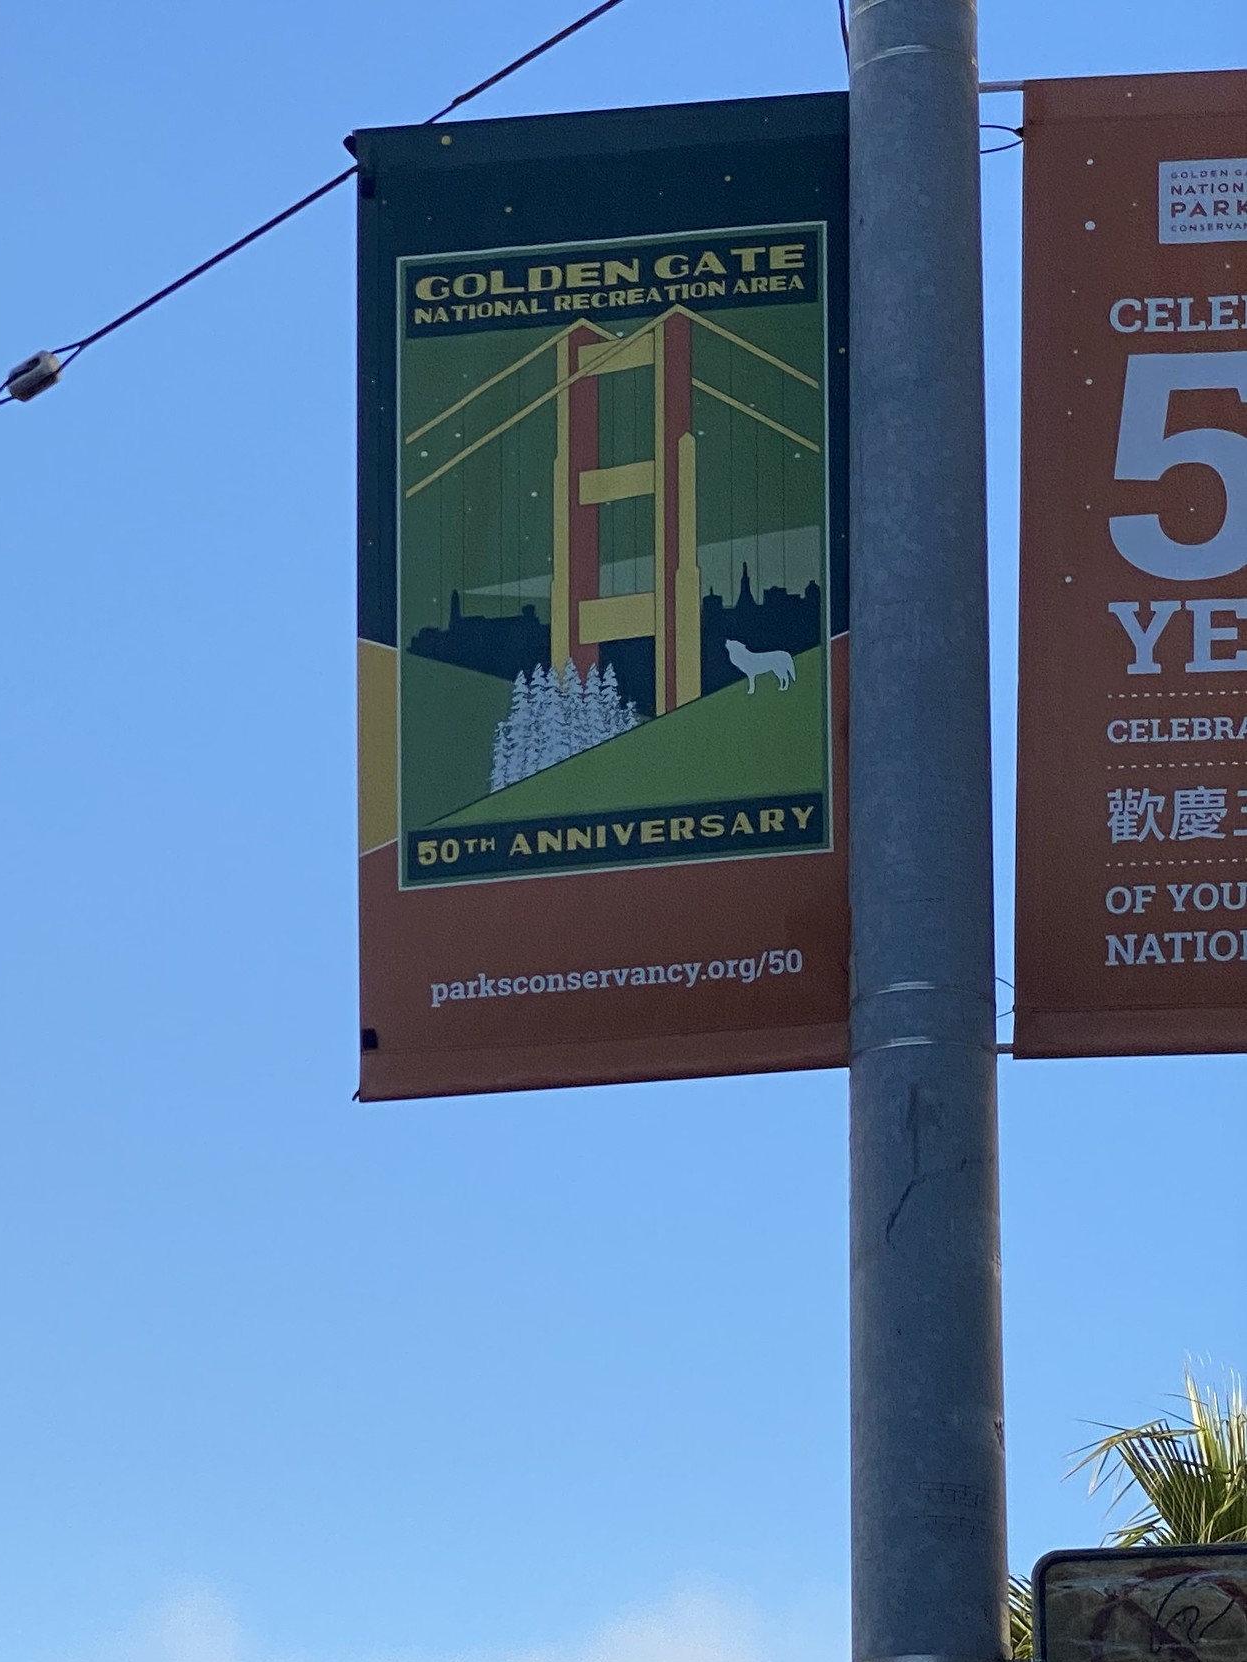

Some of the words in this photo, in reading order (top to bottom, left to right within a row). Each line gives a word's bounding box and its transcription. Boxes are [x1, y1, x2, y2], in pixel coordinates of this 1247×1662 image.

[1171, 169, 1228, 179] GOLDEN
[1171, 183, 1244, 195] NATION
[415, 257, 641, 302] GOLDEN
[654, 243, 806, 281] GATE
[413, 292, 548, 326] NATIONAL
[554, 280, 726, 312] RECREATION
[733, 274, 805, 294] AREA
[1109, 295, 1247, 333] CELE
[1108, 599, 1247, 675] YE
[417, 836, 496, 866] 50TH
[509, 805, 815, 857] ANNIVERSARY
[1106, 785, 1247, 845] 歡慶
[1105, 884, 1157, 915] OF
[1105, 929, 1247, 967] NATIO
[430, 948, 804, 1008] parksconservancy.org/50
